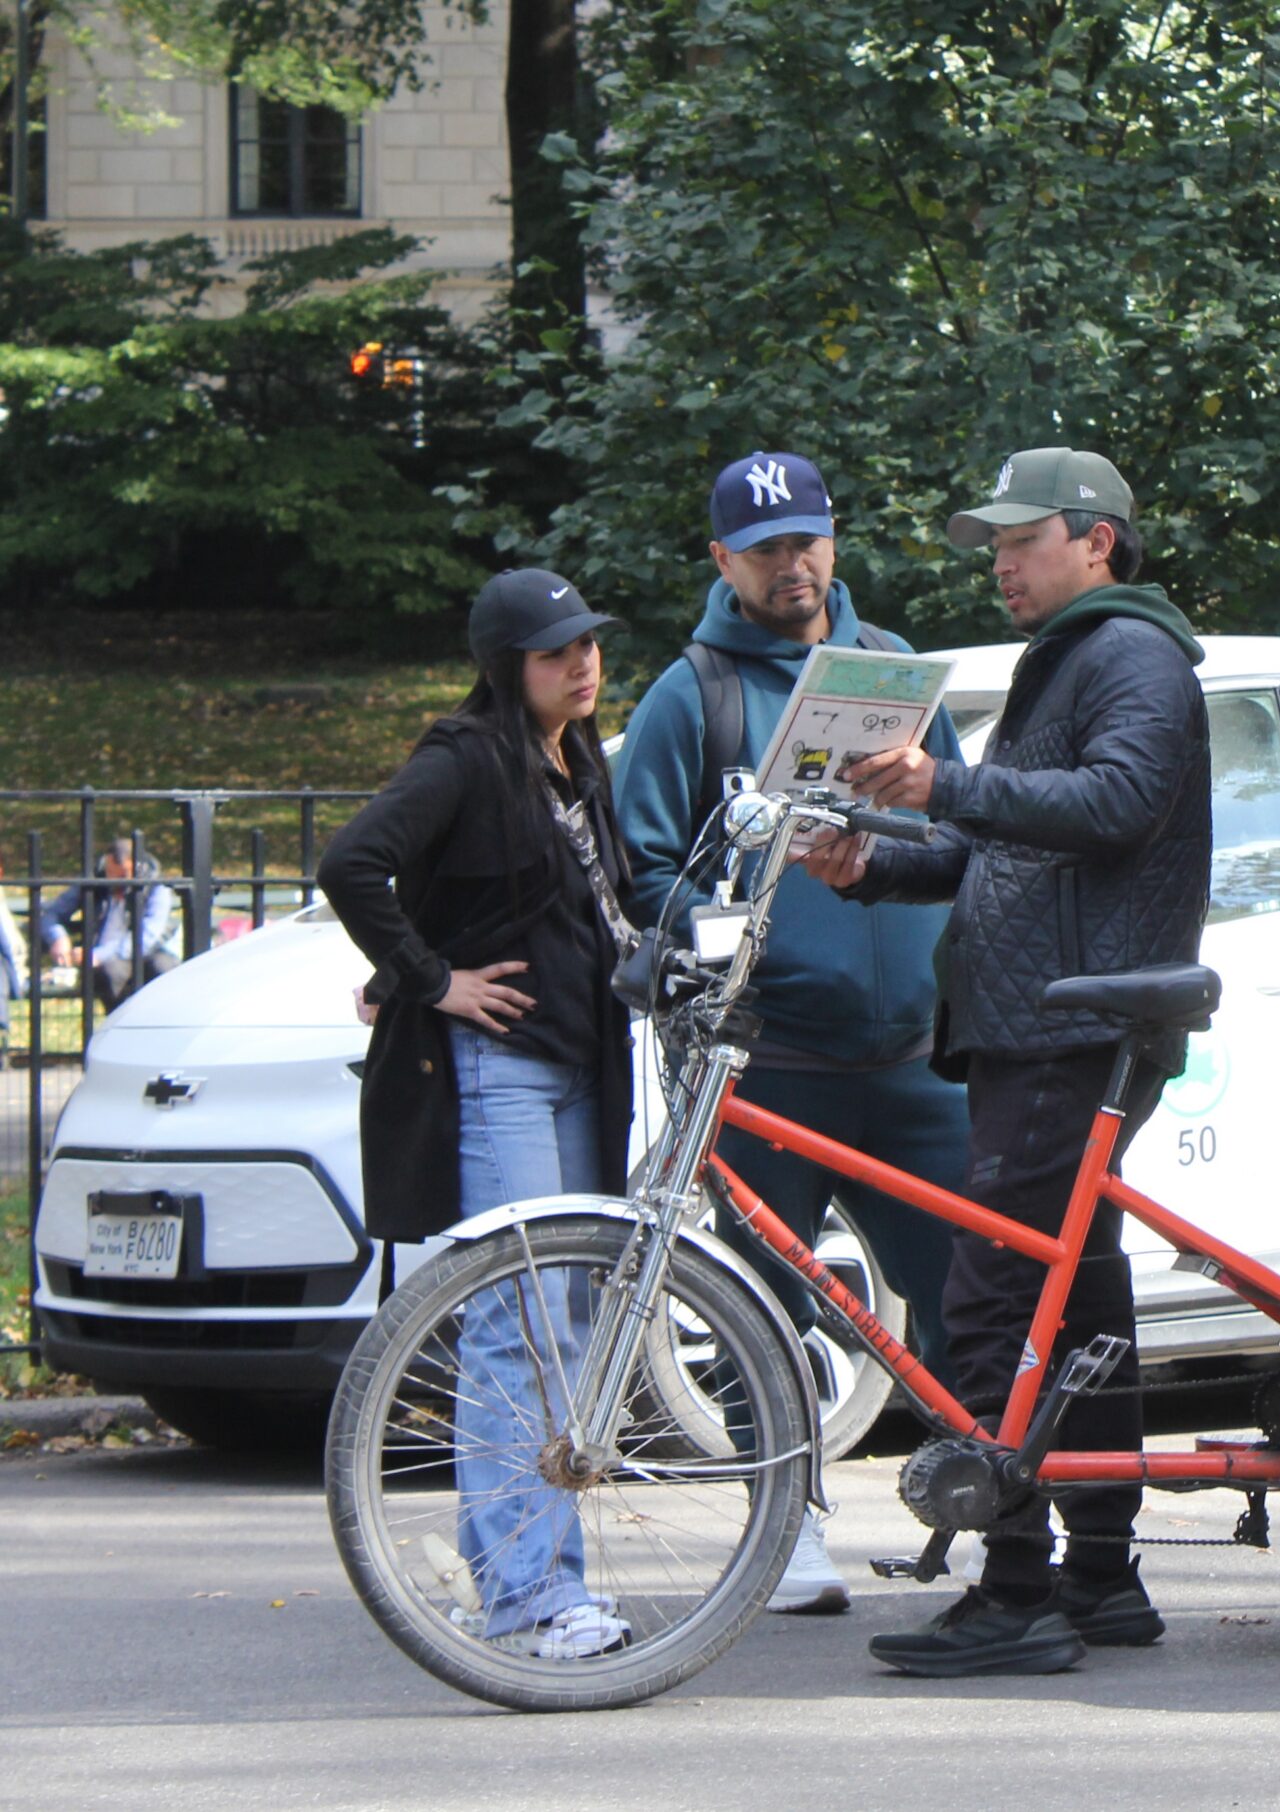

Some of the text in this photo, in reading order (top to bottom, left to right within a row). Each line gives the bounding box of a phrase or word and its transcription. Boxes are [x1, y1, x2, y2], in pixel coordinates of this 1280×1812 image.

[745, 460, 792, 507] NY
[1178, 1126, 1217, 1166] 50
[785, 1240, 906, 1365] MAIN STREET
